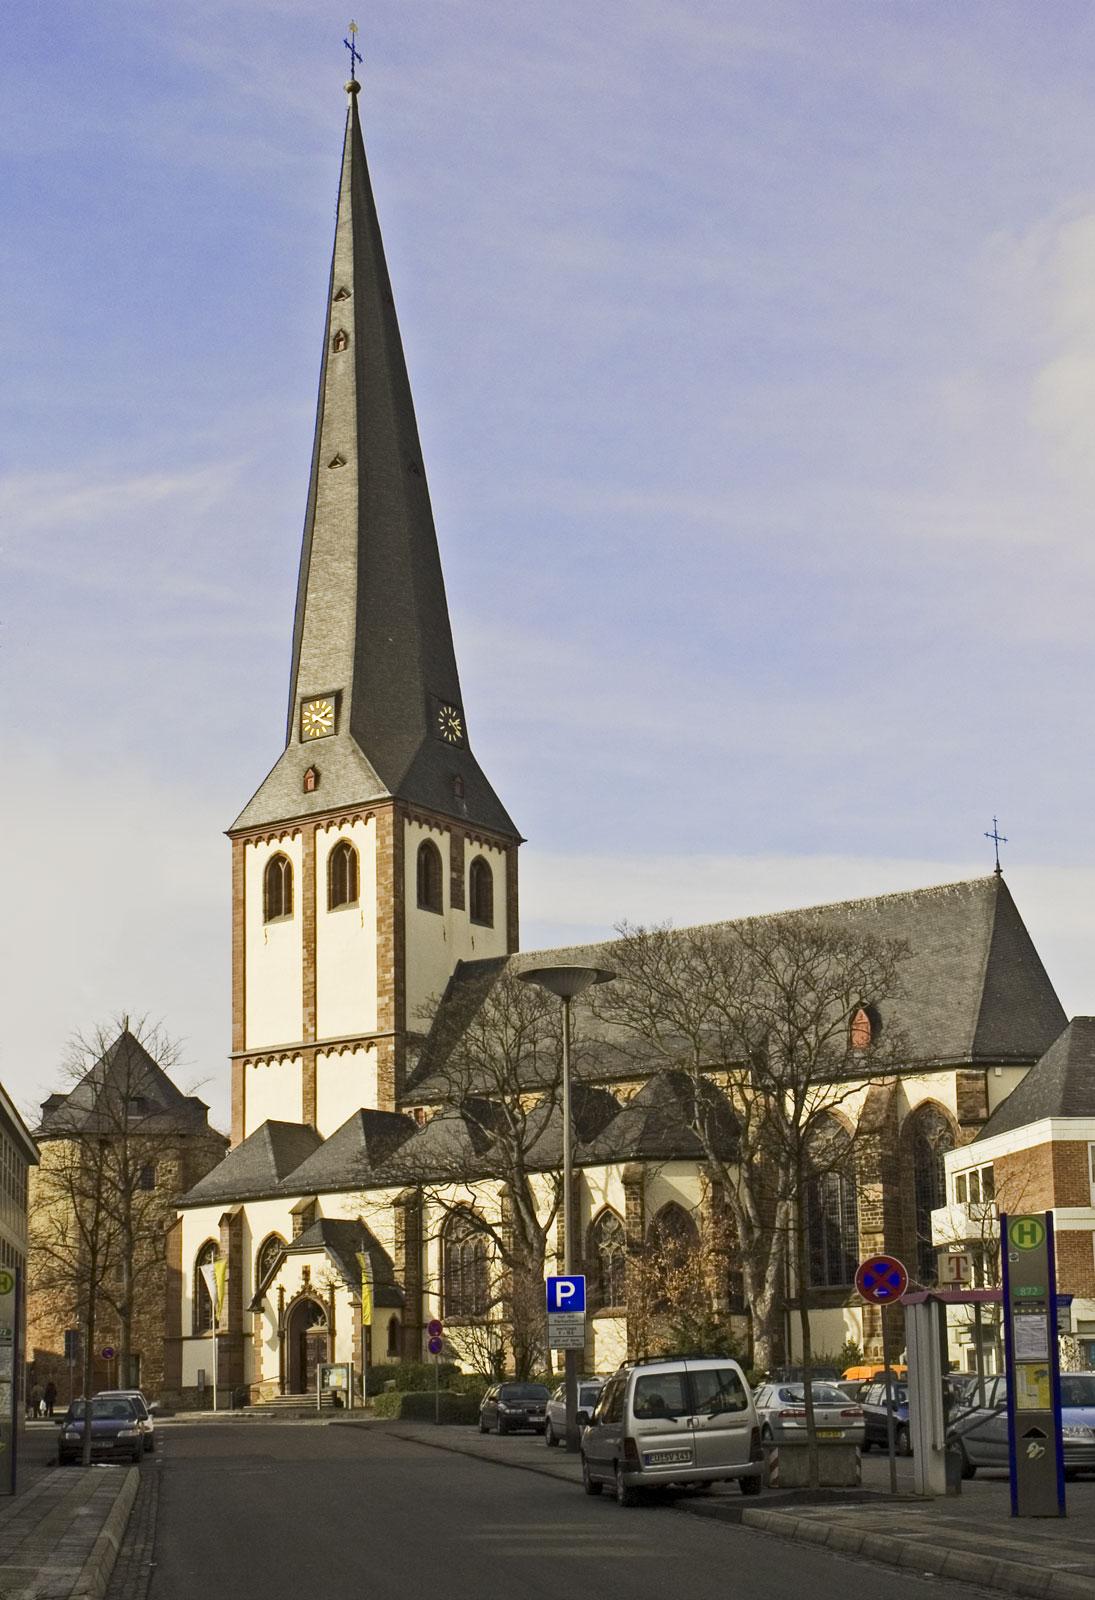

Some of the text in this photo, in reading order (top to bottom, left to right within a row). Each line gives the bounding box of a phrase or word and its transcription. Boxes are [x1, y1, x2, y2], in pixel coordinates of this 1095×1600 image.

[1018, 1223, 1037, 1244] H
[948, 1256, 968, 1280] T
[556, 1281, 576, 1307] P
